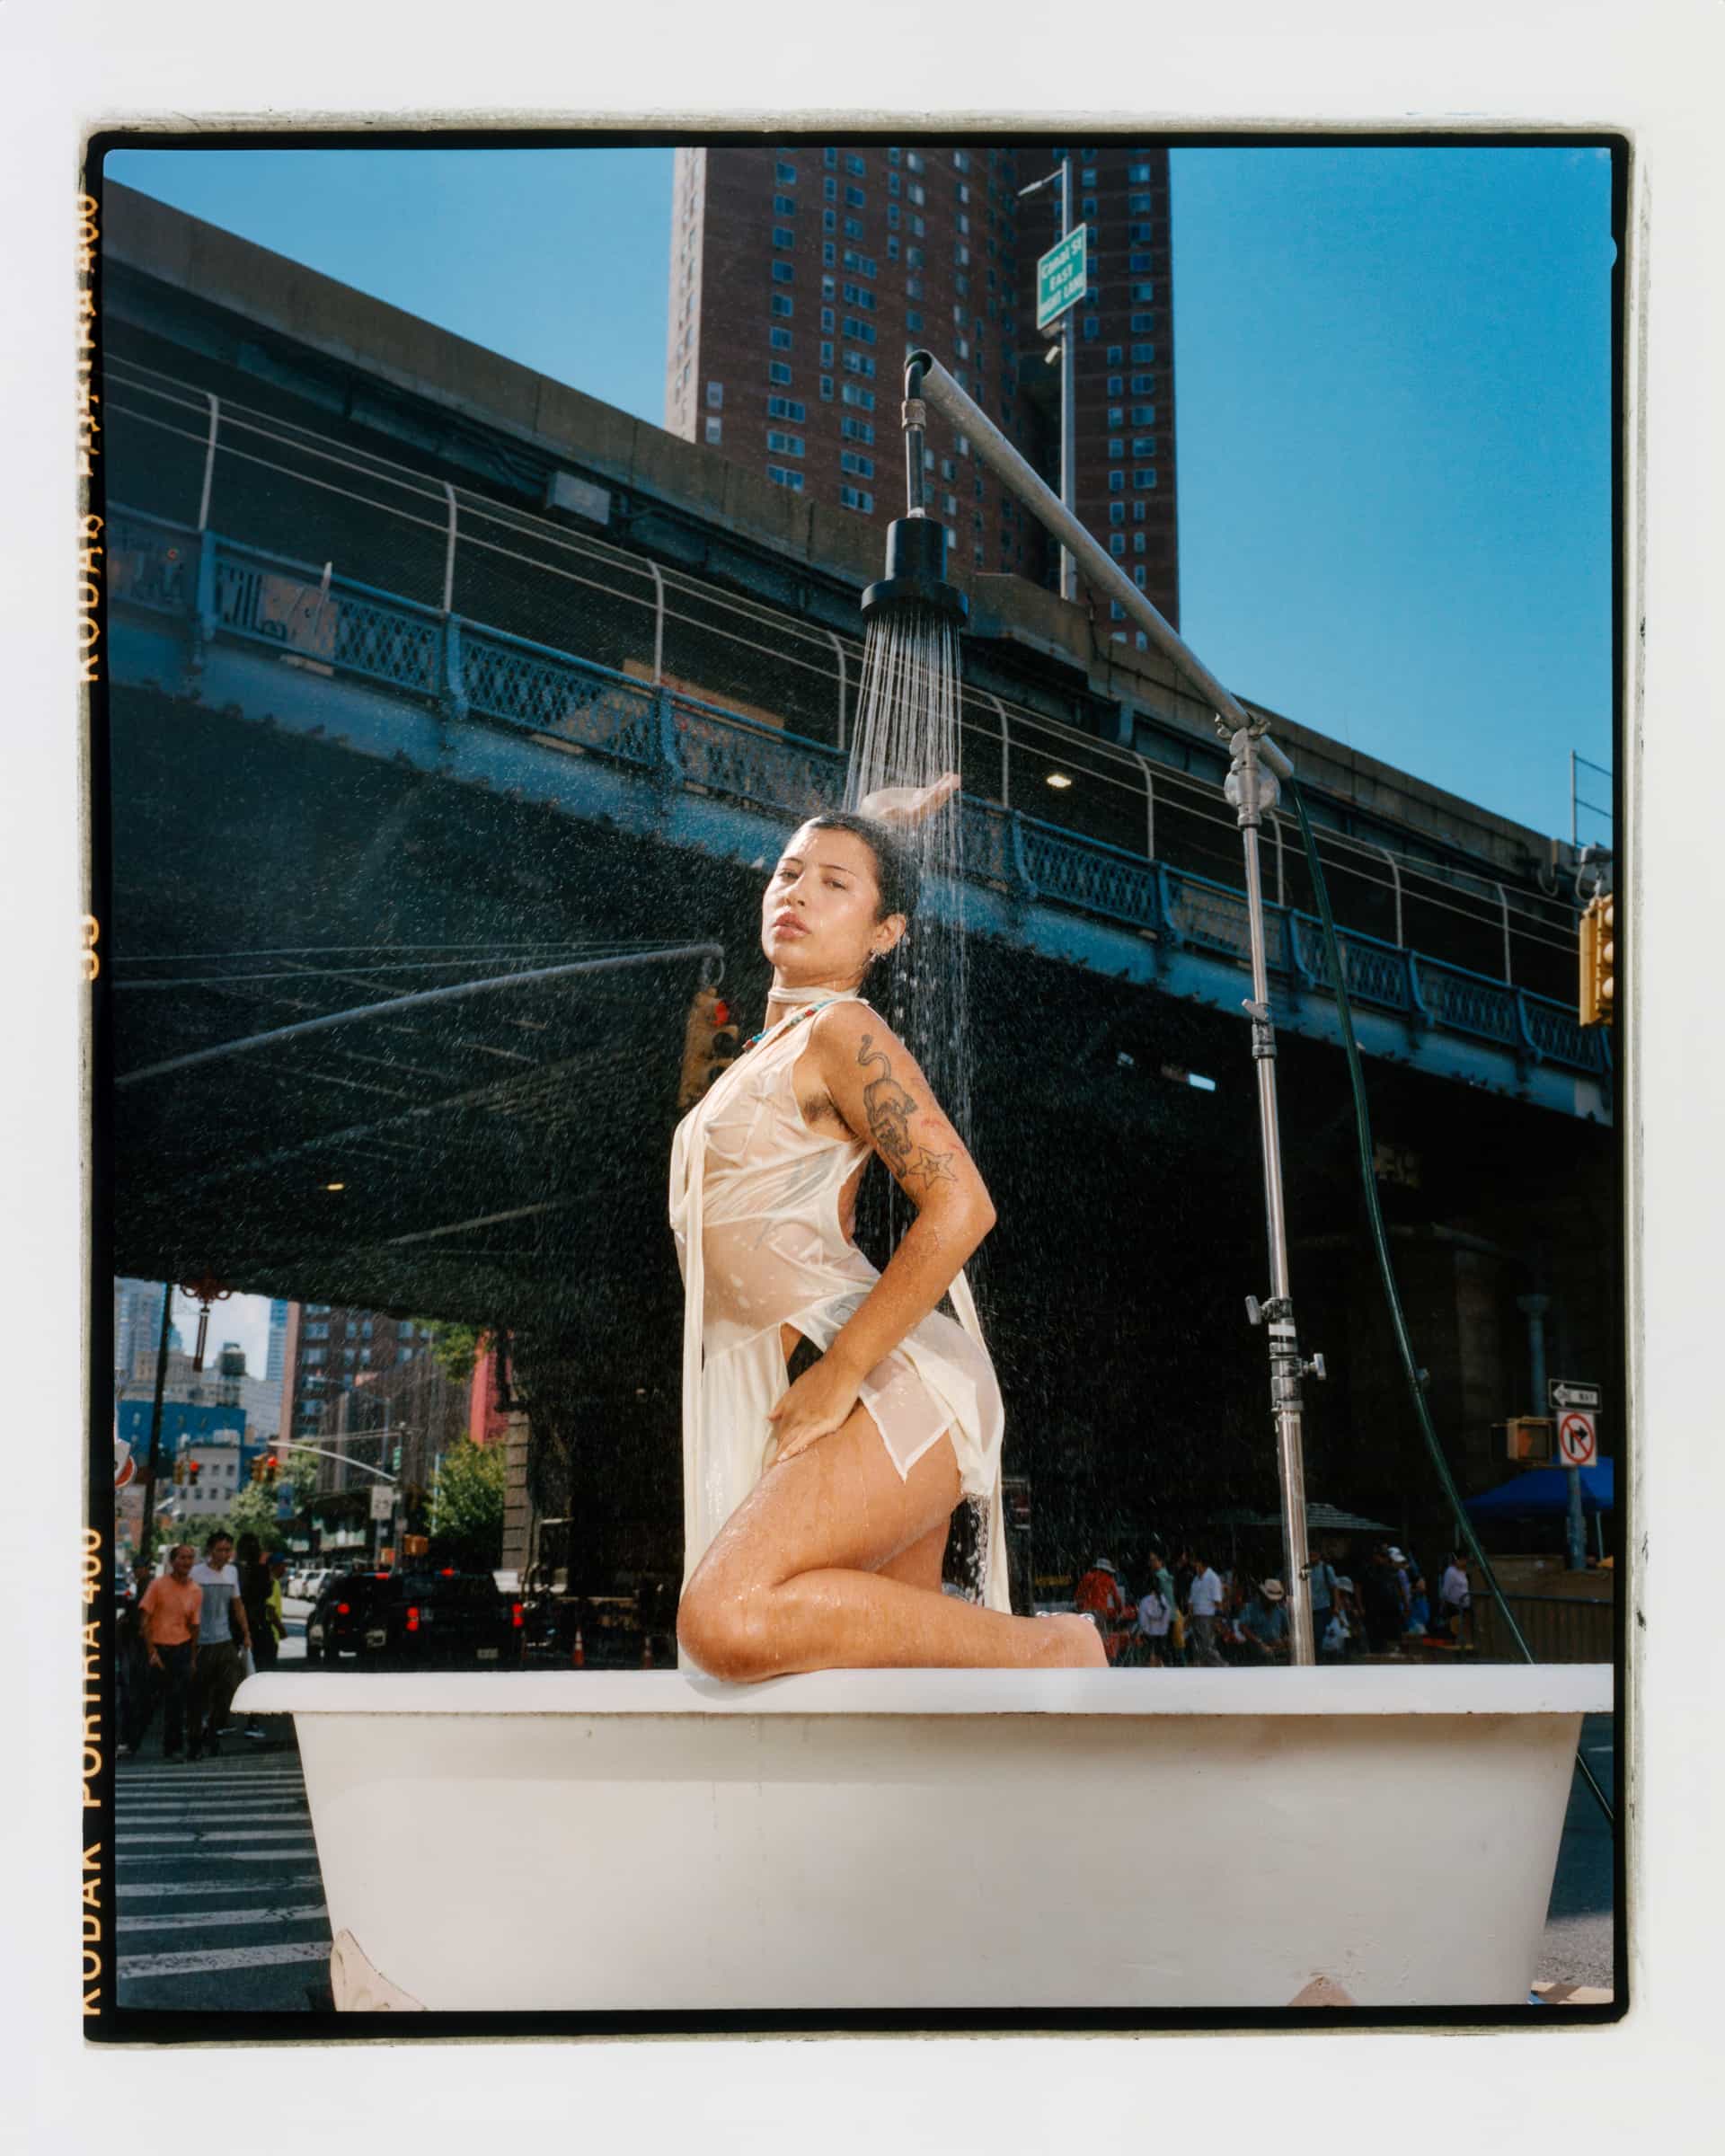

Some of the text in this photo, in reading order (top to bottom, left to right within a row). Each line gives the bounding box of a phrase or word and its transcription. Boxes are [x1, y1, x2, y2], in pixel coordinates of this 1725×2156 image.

[77, 193, 100, 274] 400
[81, 1527, 102, 2017] KODAK PORTRA 400
